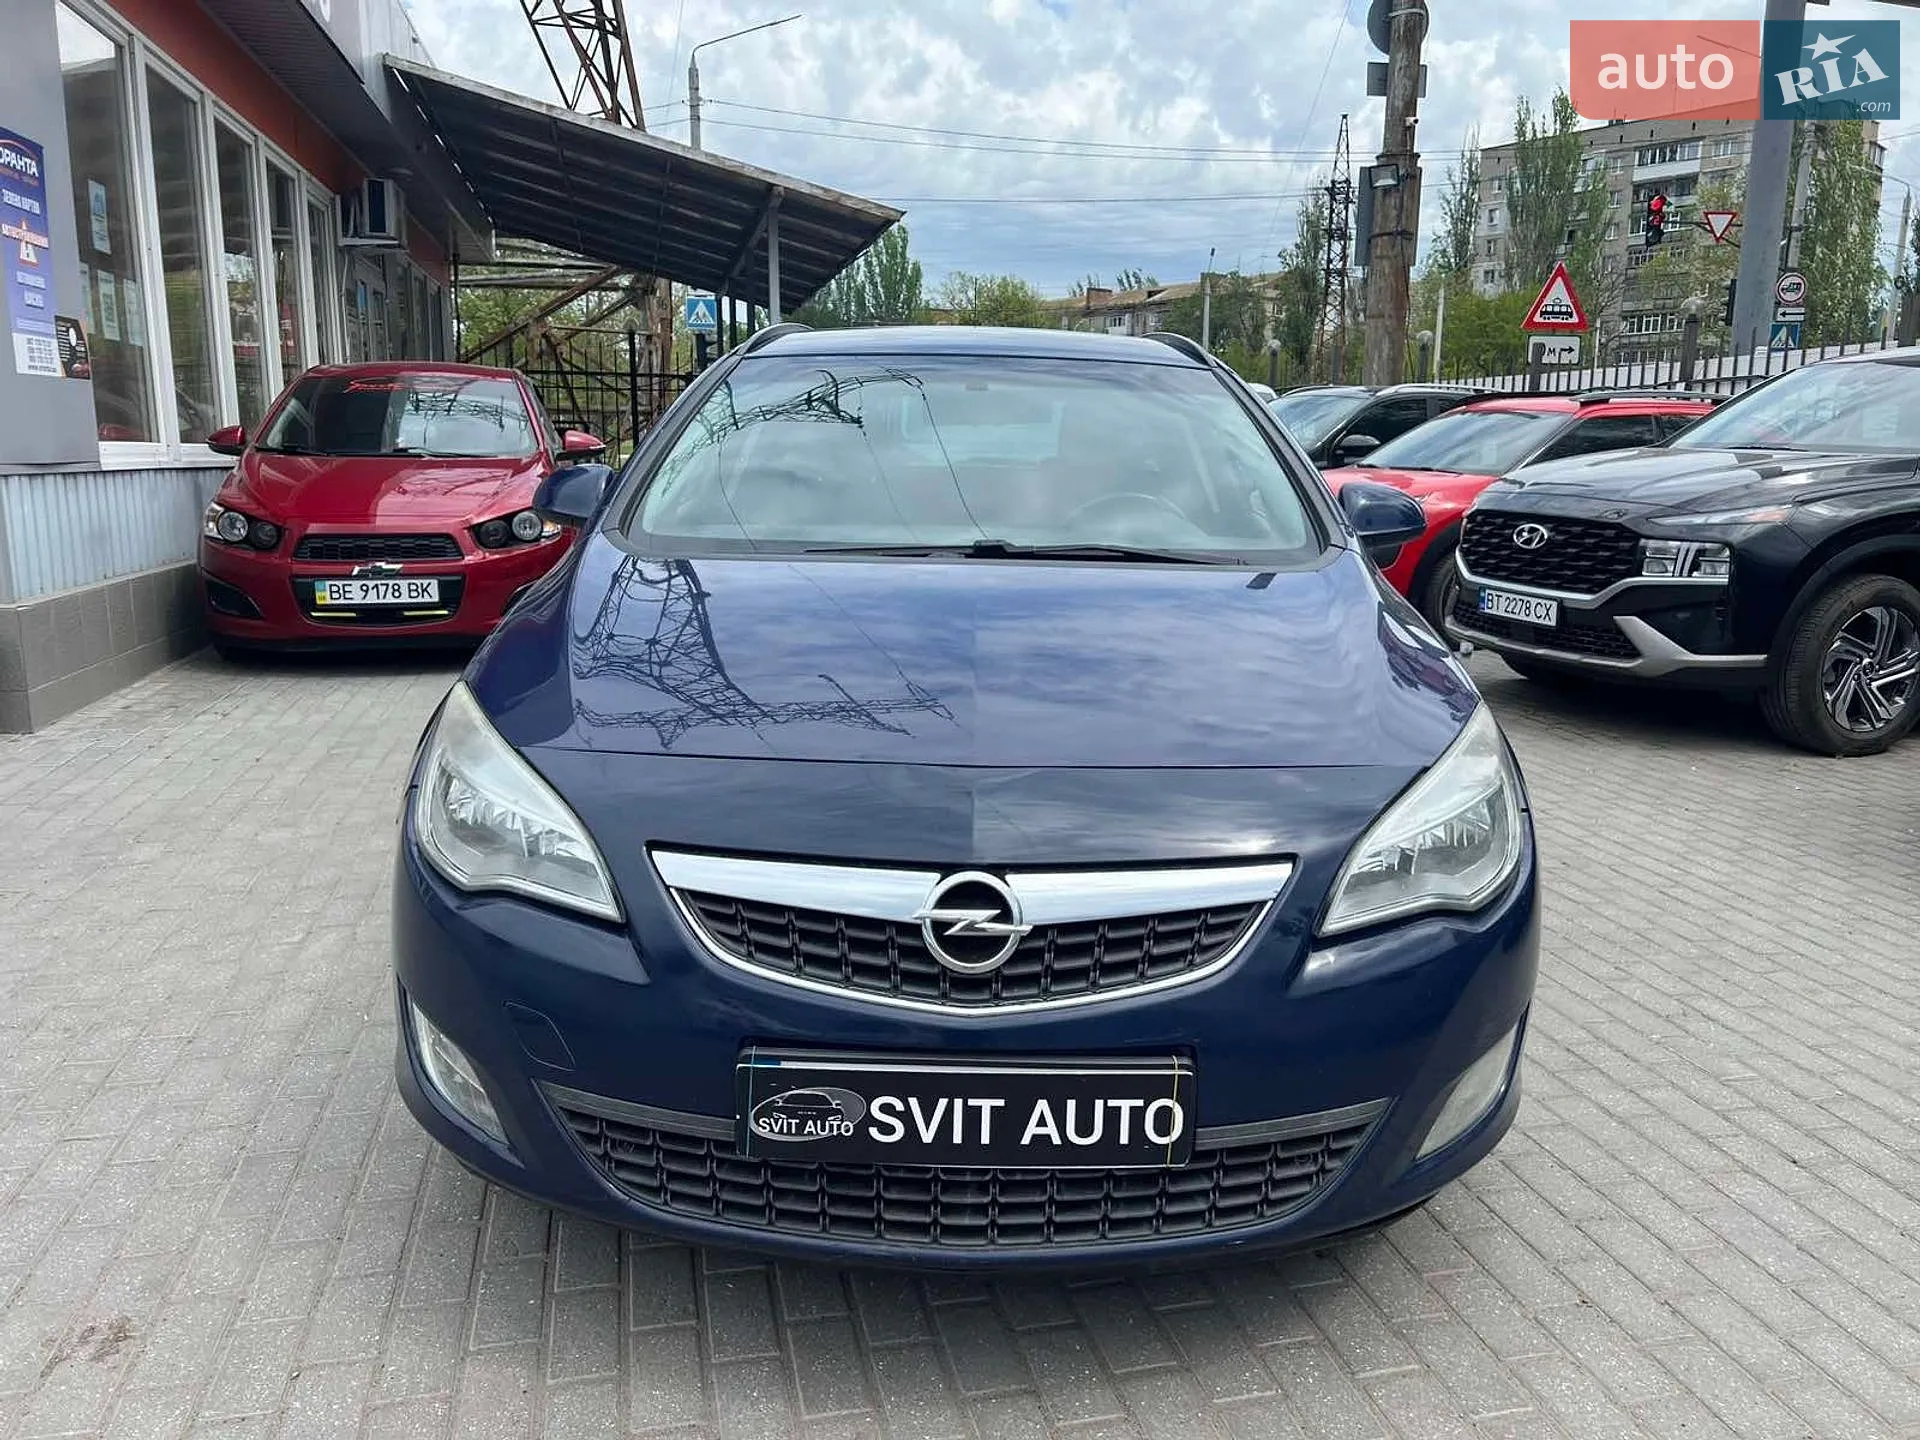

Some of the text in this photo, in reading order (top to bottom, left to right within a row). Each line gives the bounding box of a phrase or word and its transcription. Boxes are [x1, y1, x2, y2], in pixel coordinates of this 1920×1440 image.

[328, 582, 433, 600] BE 9178 BK
[1486, 593, 1553, 622] BT 2278 CX
[758, 1117, 854, 1136] SVIT AUTO
[867, 1095, 1186, 1146] SVIT AUTO
